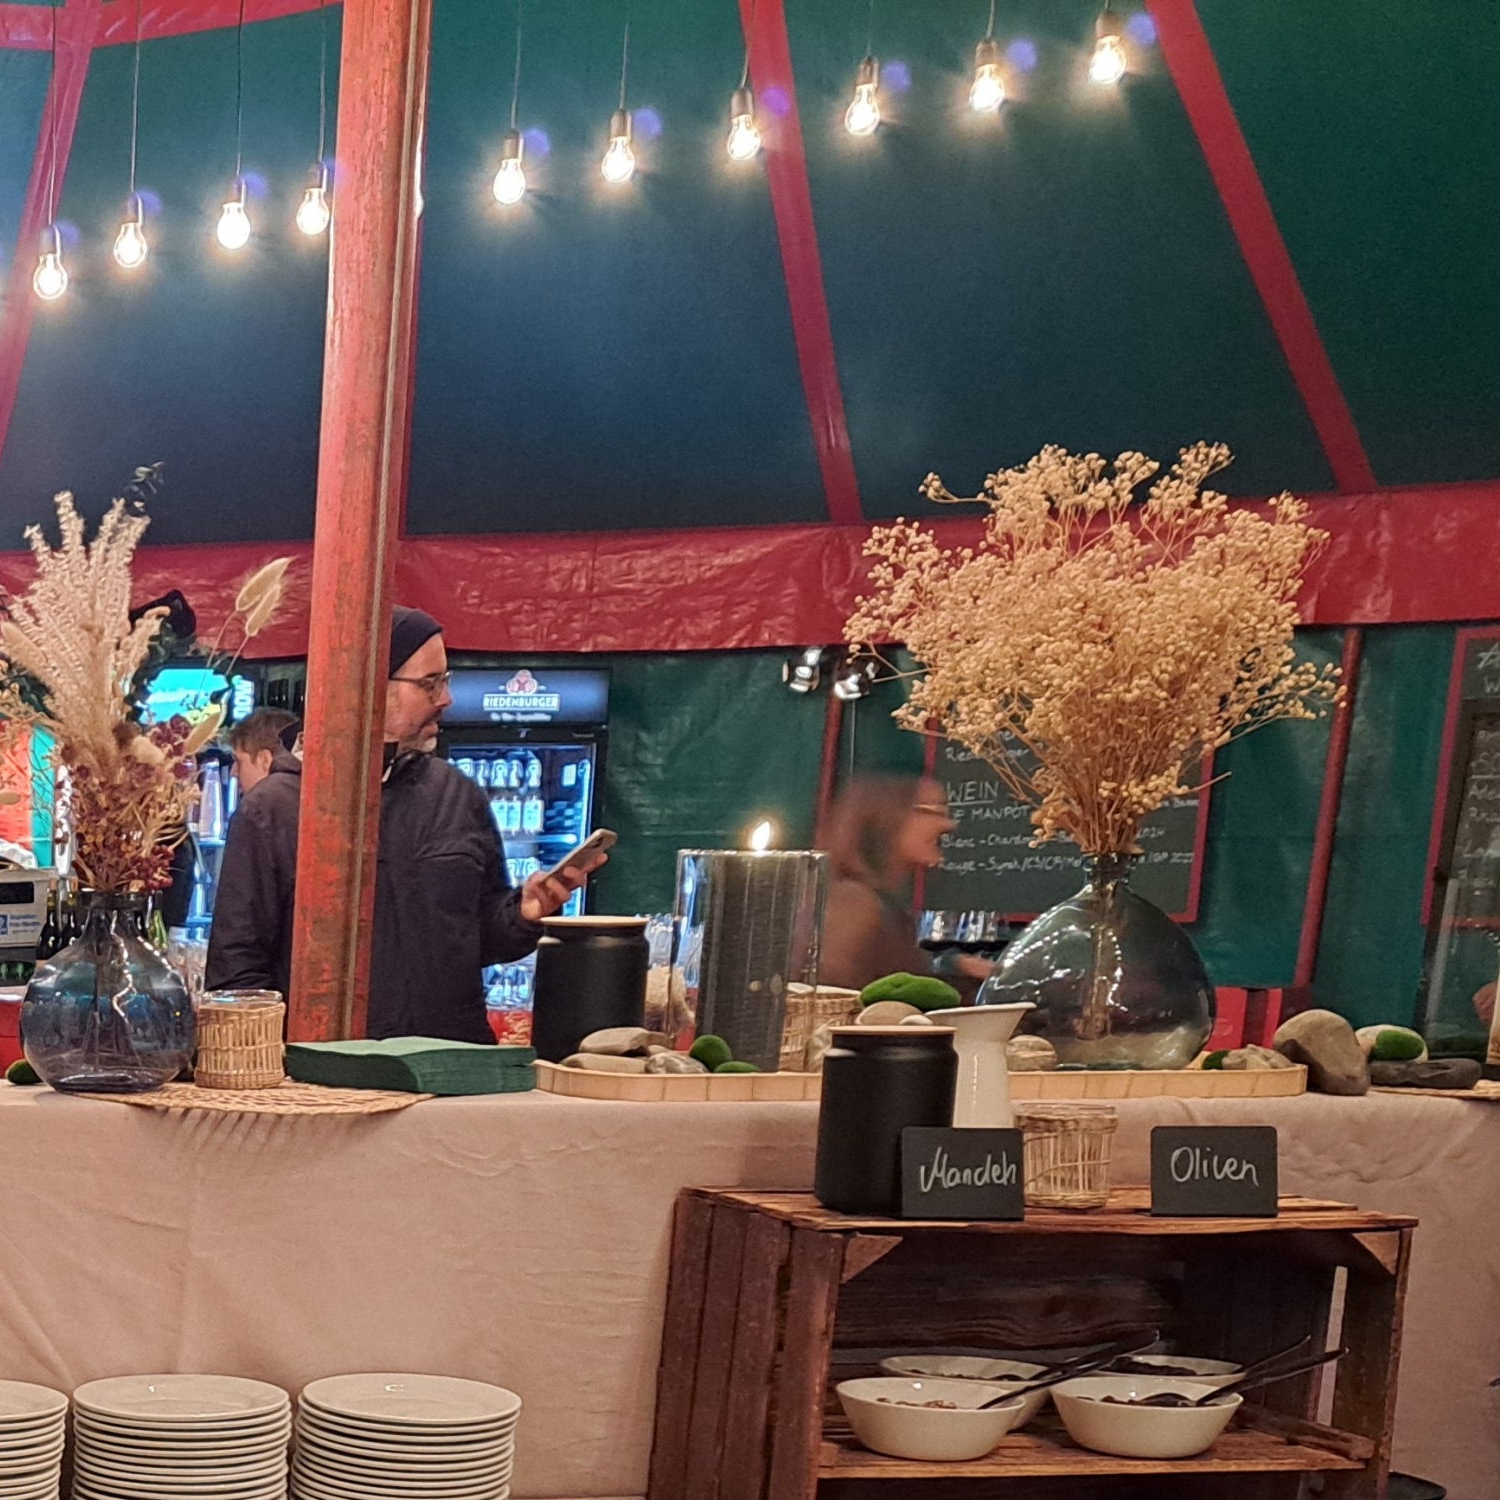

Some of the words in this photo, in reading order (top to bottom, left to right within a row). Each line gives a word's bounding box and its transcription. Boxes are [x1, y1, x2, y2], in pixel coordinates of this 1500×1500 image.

[483, 697, 558, 707] RIEDENBURGER
[947, 781, 1002, 803] WEIN
[1171, 1146, 1259, 1187] Oliven
